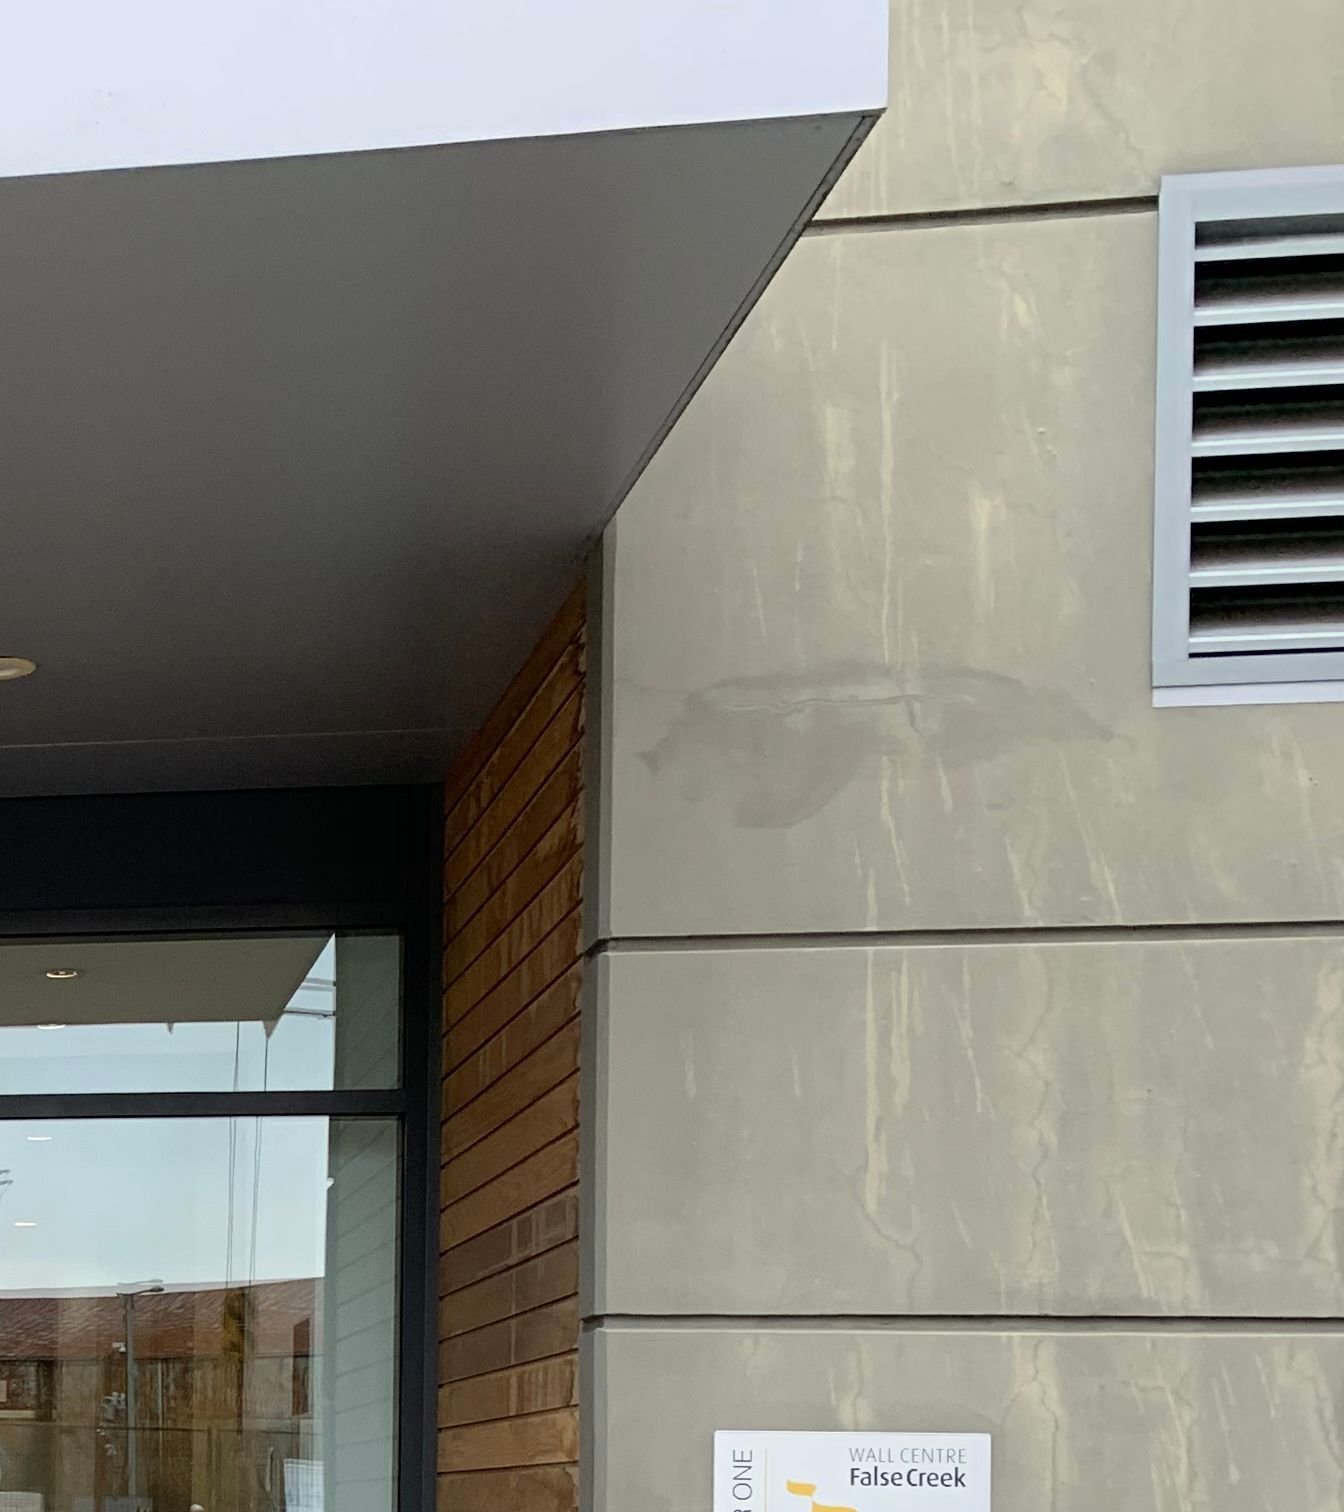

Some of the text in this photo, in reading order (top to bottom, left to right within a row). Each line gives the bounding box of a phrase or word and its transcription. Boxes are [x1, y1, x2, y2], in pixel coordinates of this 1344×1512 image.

[849, 1448, 967, 1464] WALL CENTRE
[732, 1449, 753, 1501] ONE
[850, 1466, 967, 1488] False Creek
